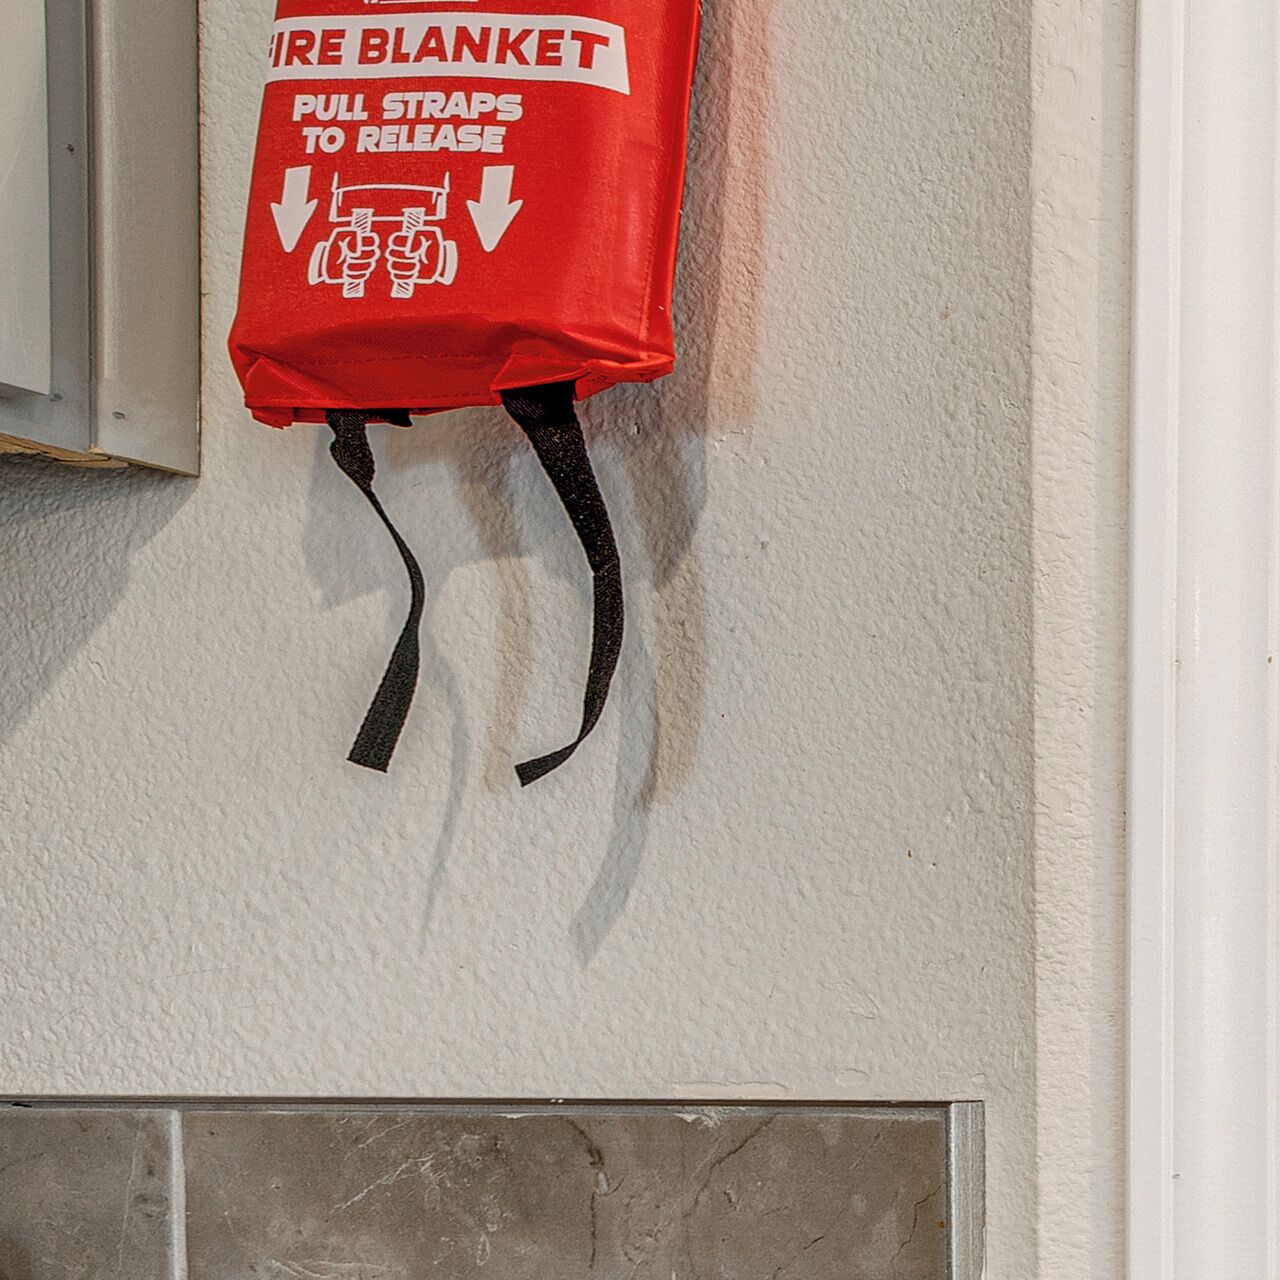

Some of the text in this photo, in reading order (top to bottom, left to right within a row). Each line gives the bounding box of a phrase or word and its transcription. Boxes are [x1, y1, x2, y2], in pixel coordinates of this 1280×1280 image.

[269, 26, 610, 69] IRE BLANKET
[292, 91, 524, 122] PULL STRAPS
[301, 124, 506, 154] TO RELEASE
